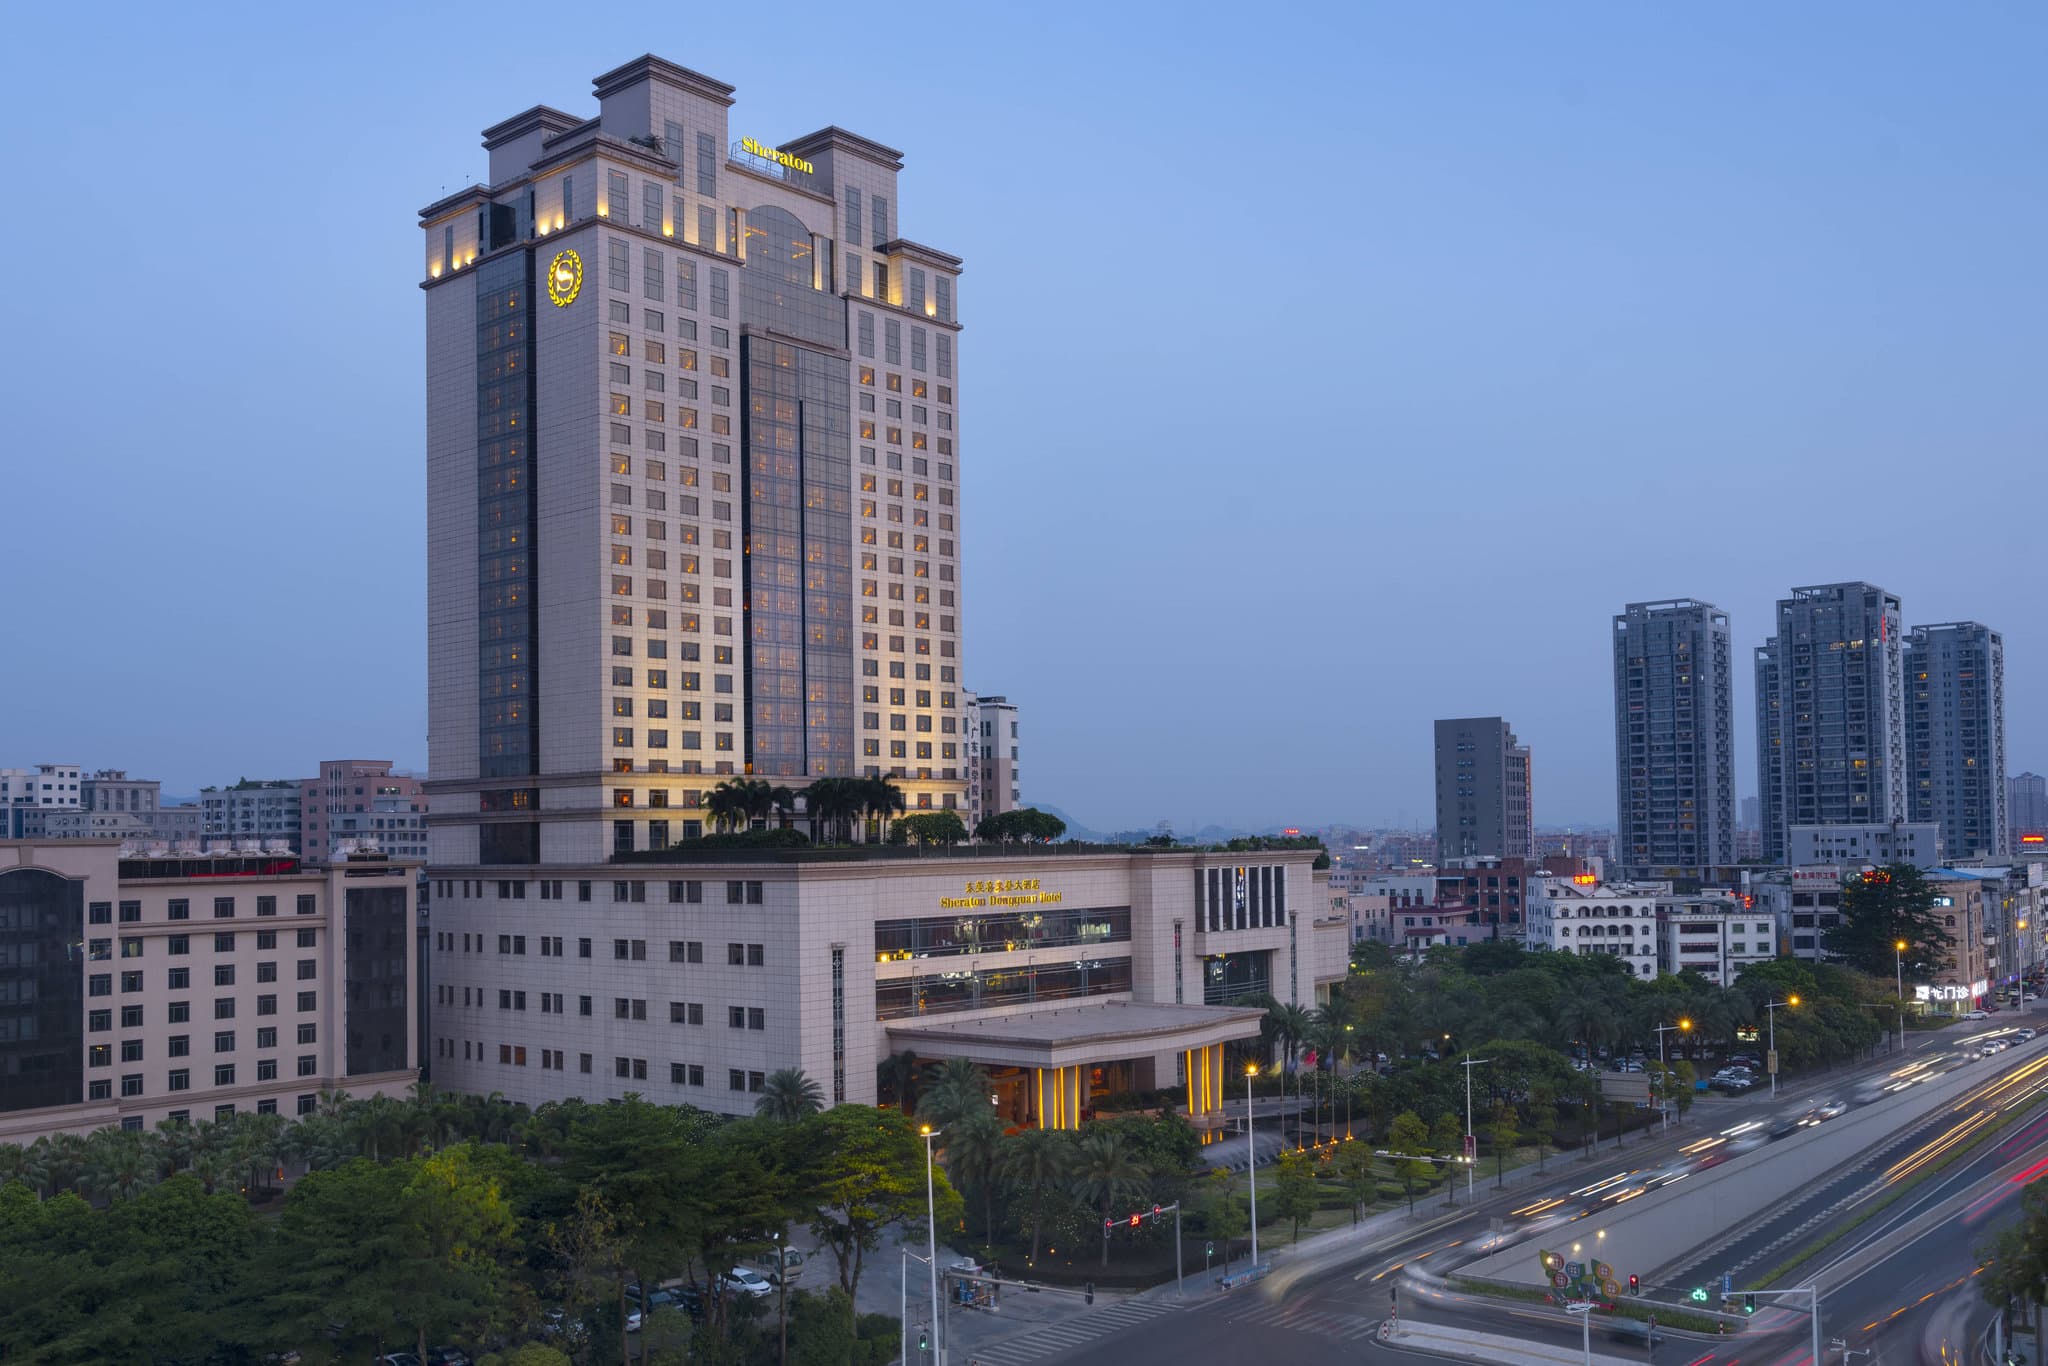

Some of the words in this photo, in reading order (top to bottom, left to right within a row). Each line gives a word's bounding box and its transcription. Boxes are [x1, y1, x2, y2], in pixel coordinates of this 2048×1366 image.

[742, 135, 814, 174] Sheraton
[941, 894, 986, 908] Sheraton
[989, 893, 1038, 907] Dongguan
[1039, 889, 1062, 904] Hotel
